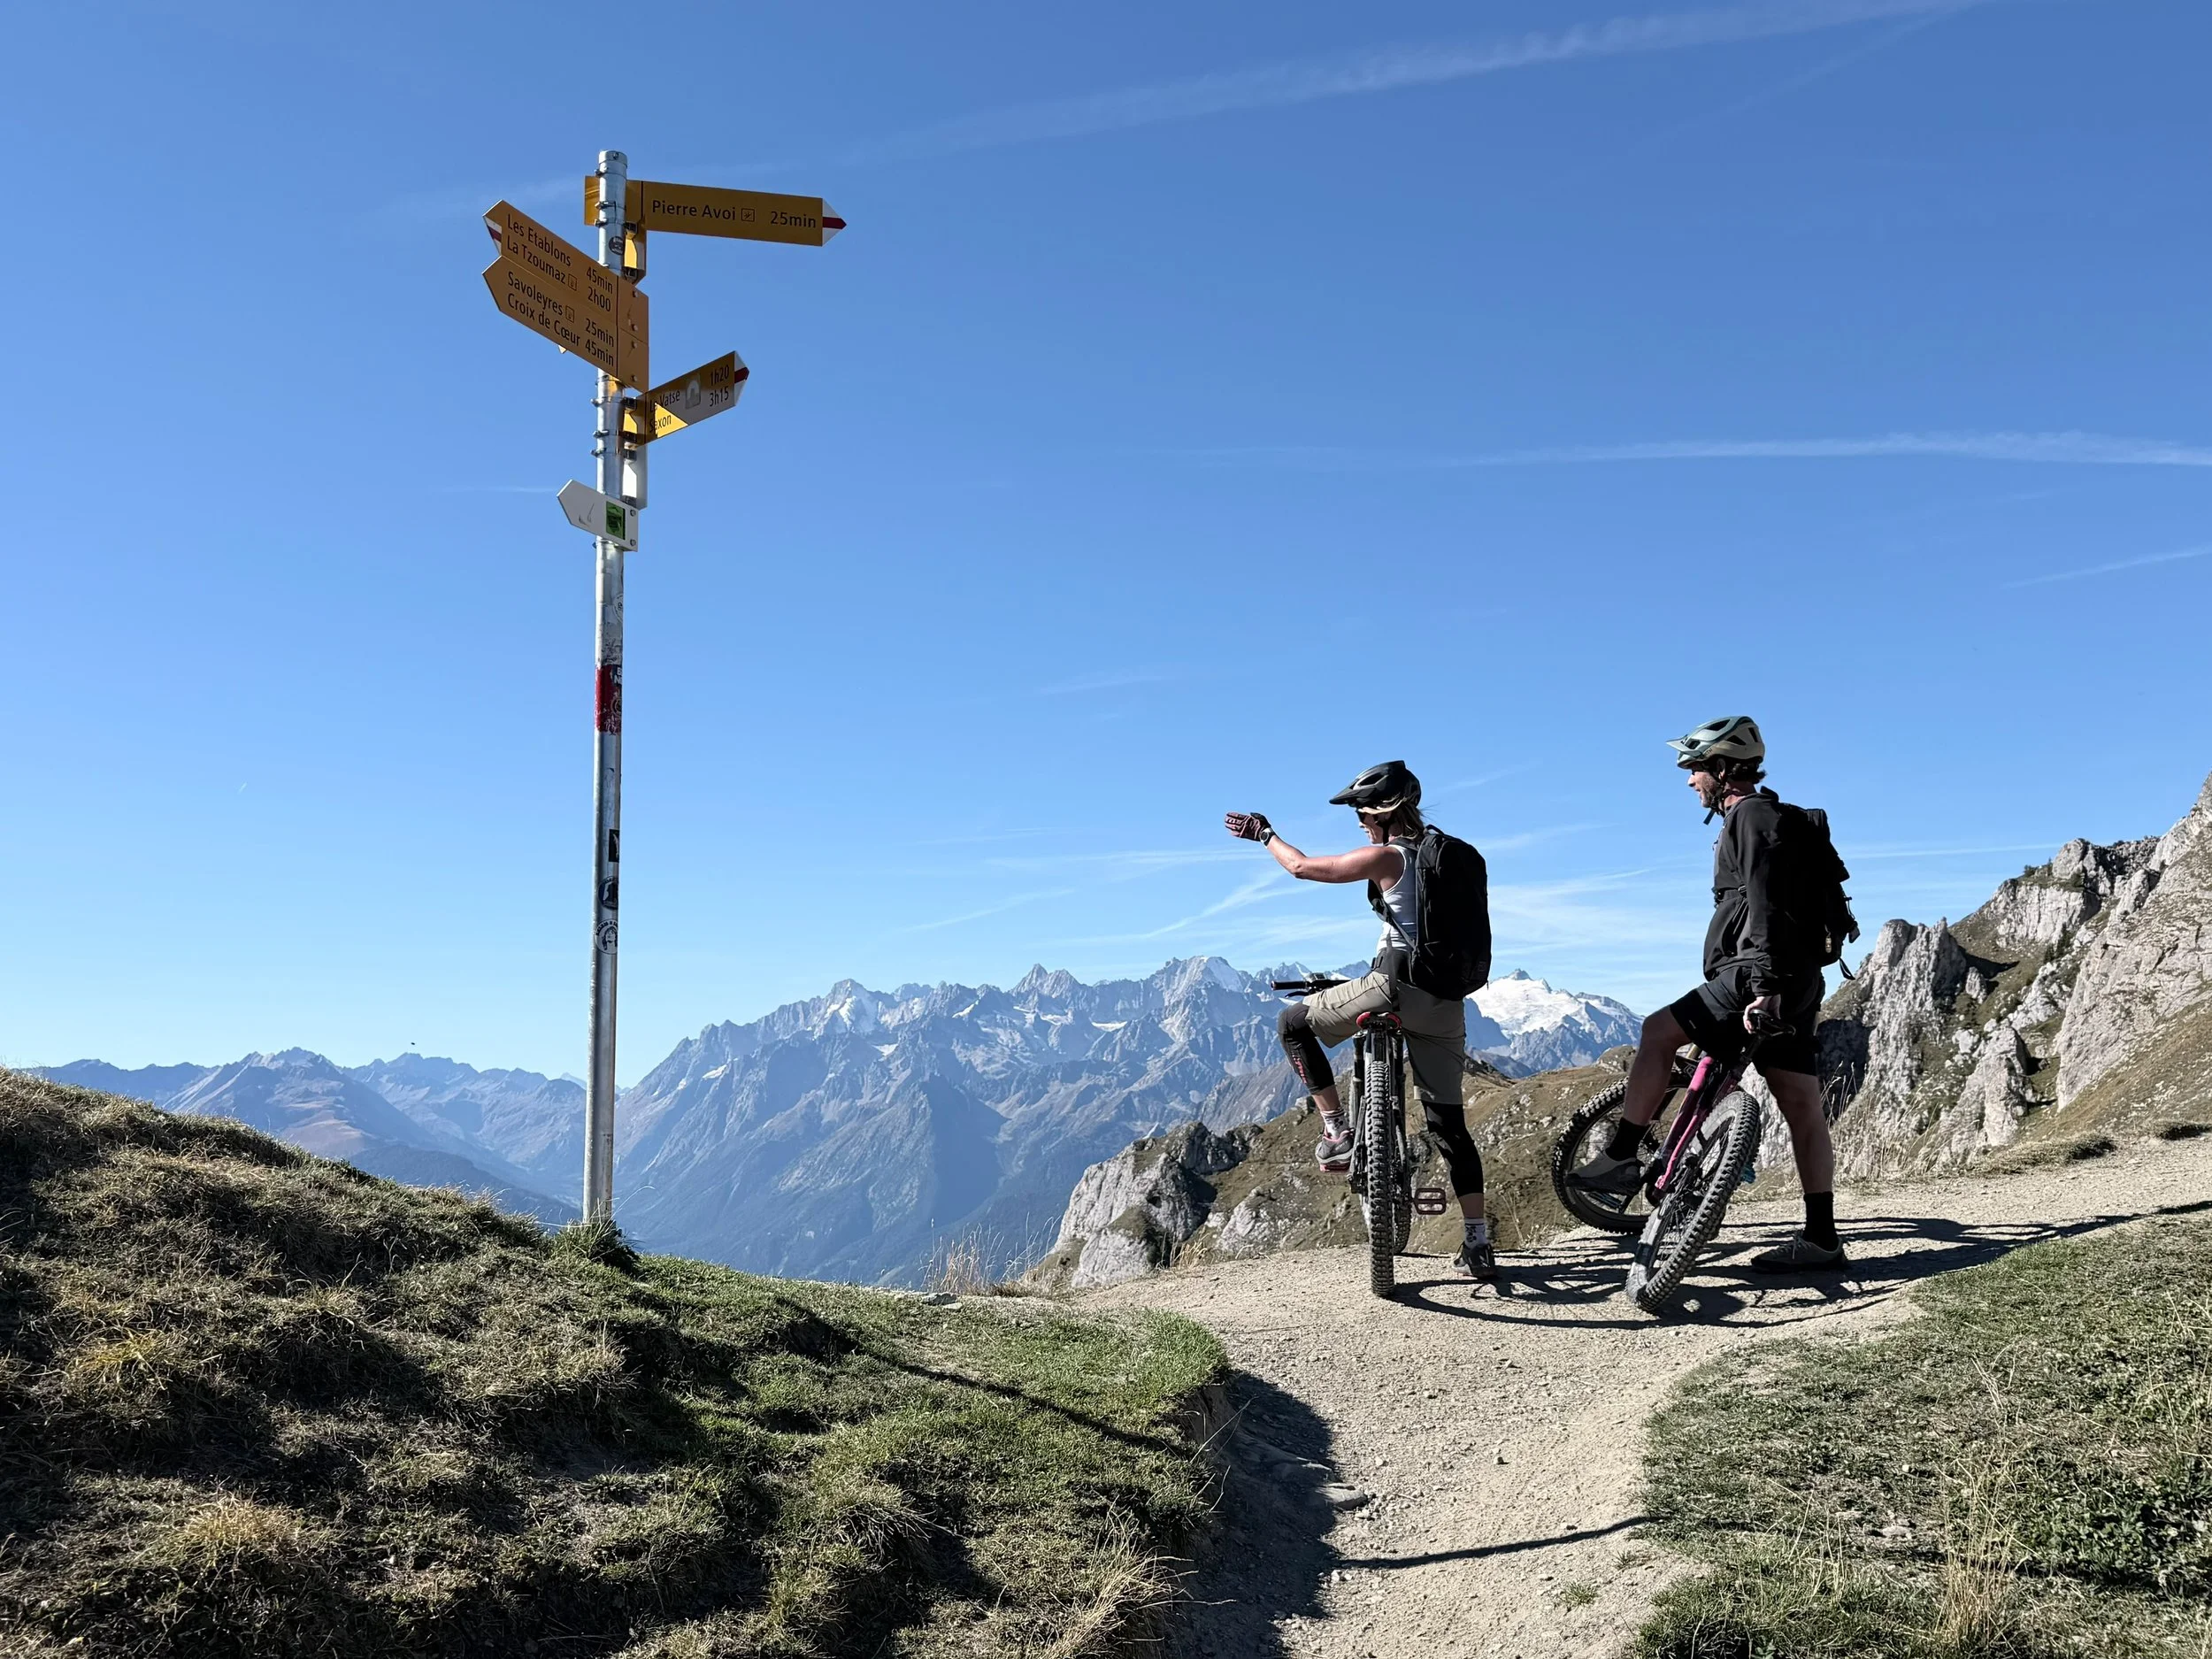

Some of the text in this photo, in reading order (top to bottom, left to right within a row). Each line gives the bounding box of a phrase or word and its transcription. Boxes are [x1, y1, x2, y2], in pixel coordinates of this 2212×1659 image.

[652, 200, 817, 229] Pierre Avoi 25min
[507, 213, 613, 295] Les Etablons 45min
[507, 235, 611, 312] La Tzoumaz 2h00
[508, 271, 615, 348] Savoleyres 25min
[508, 293, 615, 367] Croix de Cœur 45min
[649, 383, 729, 432] Saxon 3h15
[659, 389, 680, 408] Vatse
[710, 365, 730, 386] 1h20
